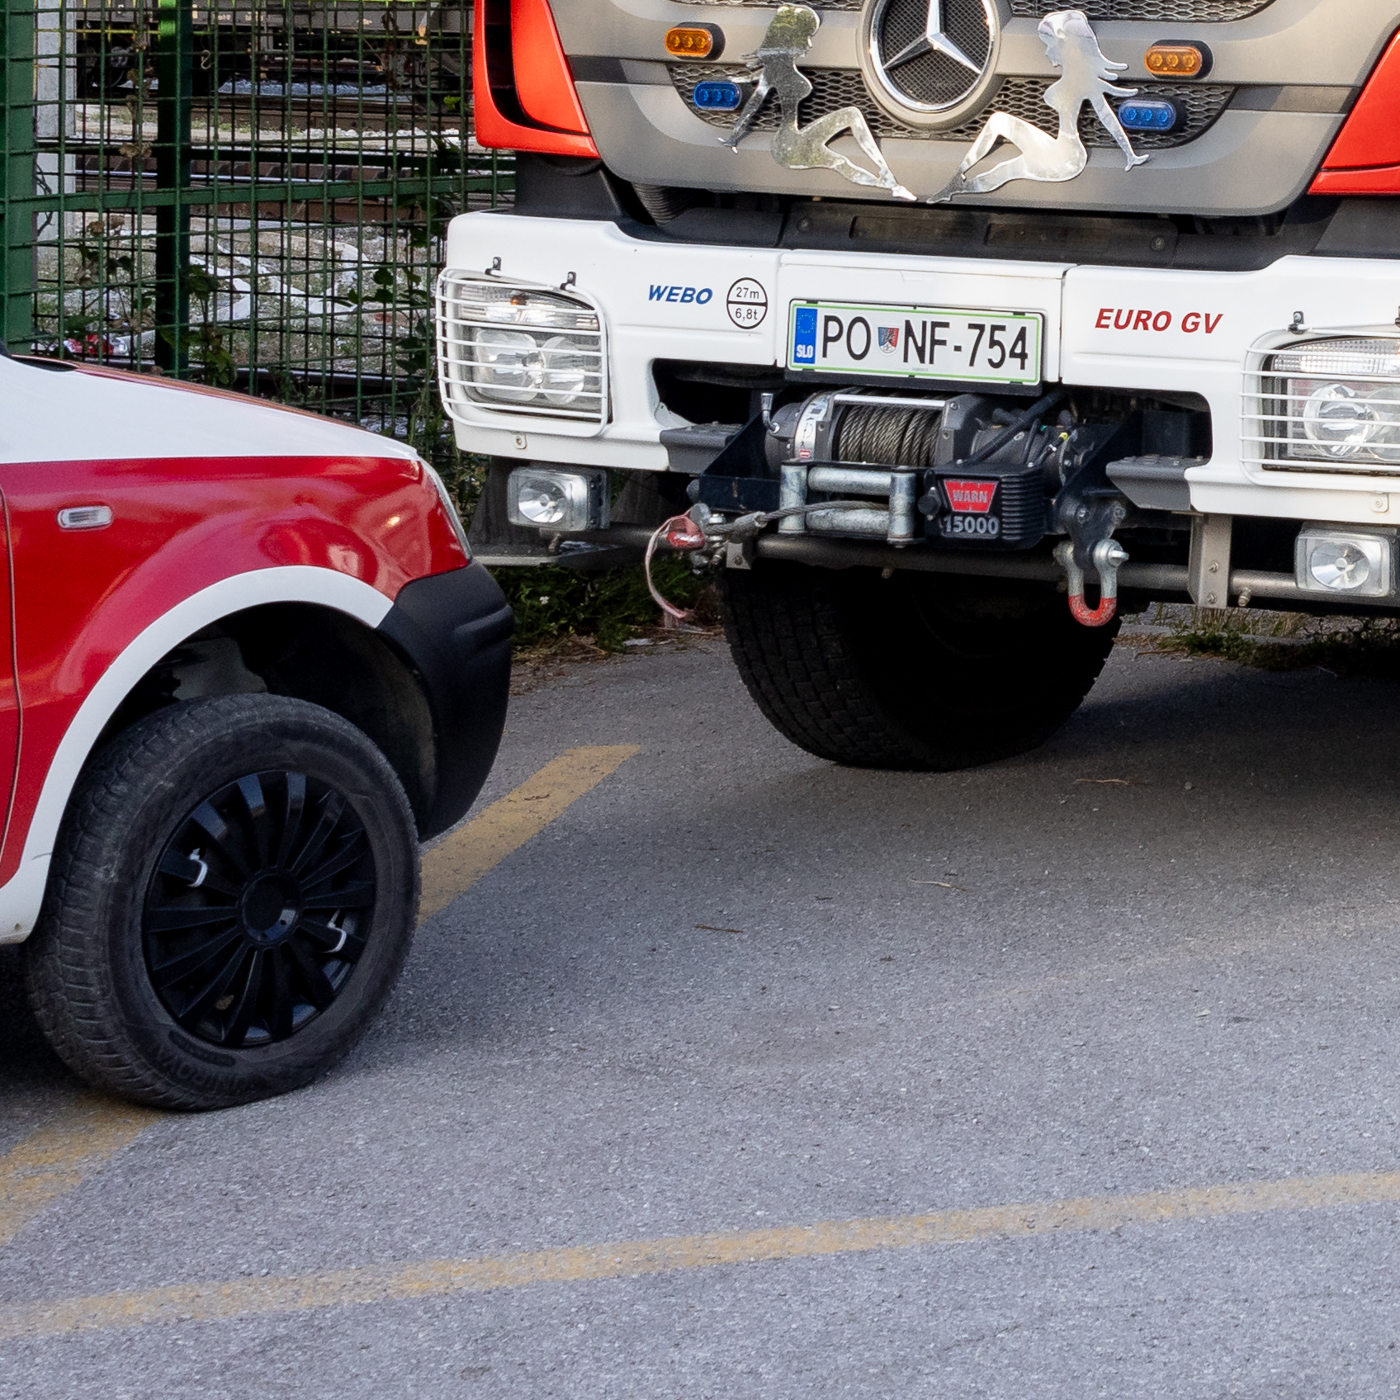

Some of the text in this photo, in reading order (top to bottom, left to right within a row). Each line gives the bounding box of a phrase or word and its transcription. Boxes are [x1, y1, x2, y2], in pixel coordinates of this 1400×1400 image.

[648, 284, 713, 305] WEBO
[735, 307, 758, 322] 6,8t
[1095, 308, 1223, 334] EURO GV
[796, 344, 813, 359] SLO
[822, 315, 1029, 371] PO NF-754
[952, 489, 988, 503] WARN
[943, 516, 999, 534] 15000
